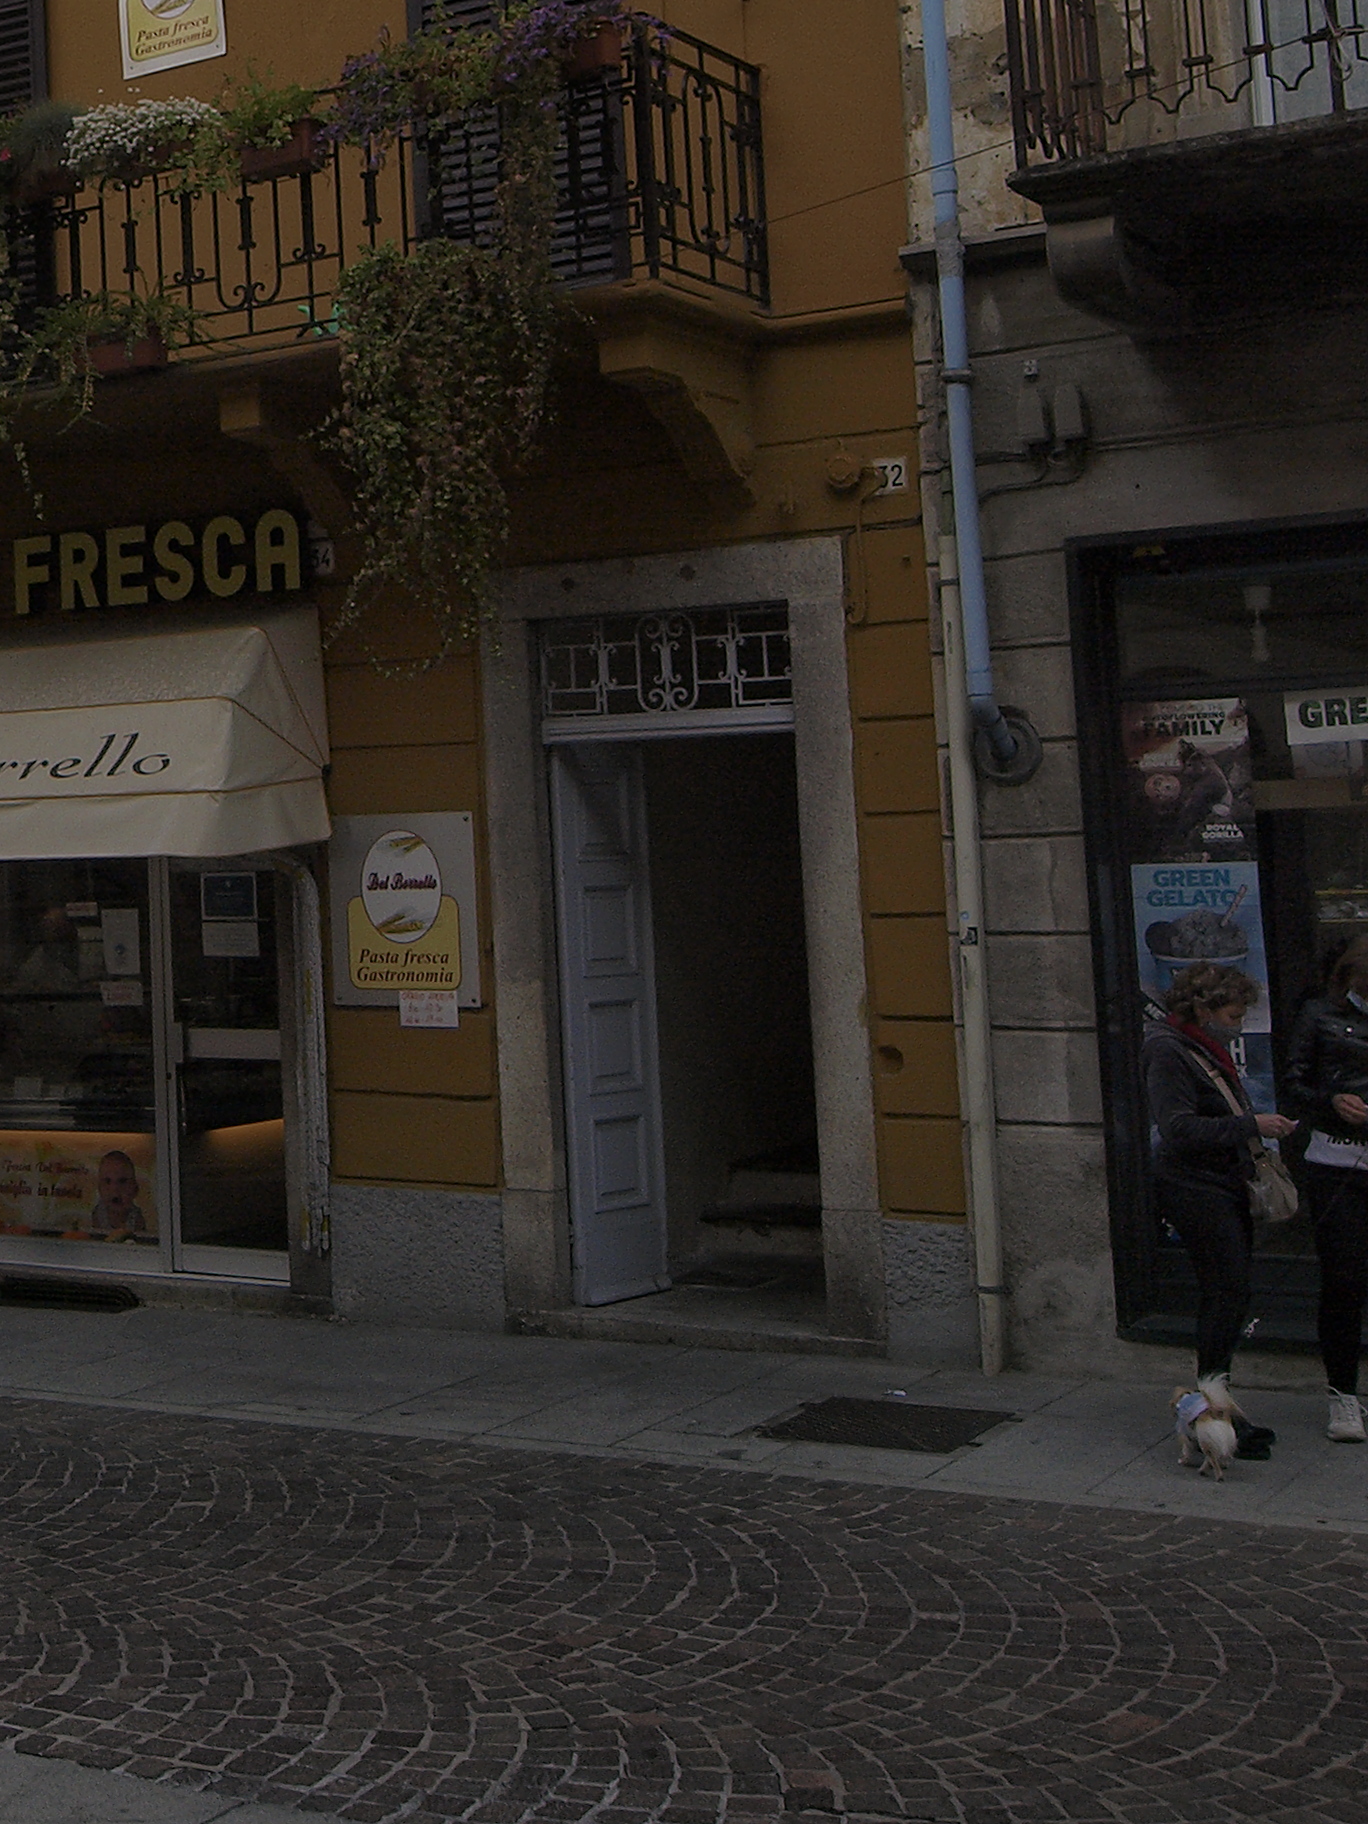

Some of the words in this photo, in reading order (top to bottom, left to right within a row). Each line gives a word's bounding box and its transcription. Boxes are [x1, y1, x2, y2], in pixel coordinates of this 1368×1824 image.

[136, 26, 169, 43] Pasta
[171, 14, 210, 37] fresca
[135, 27, 213, 57] Gastronomia
[13, 508, 302, 615] FRESCA
[1298, 696, 1368, 728] GRE
[1142, 719, 1224, 737] FAMILY
[367, 872, 390, 891] Del
[390, 872, 437, 891] Borrello
[1153, 869, 1231, 888] GREEN
[1146, 888, 1240, 908] GELATO
[359, 948, 398, 965] Pasta
[401, 948, 450, 967] fresca
[357, 966, 454, 983] Gastronomia
